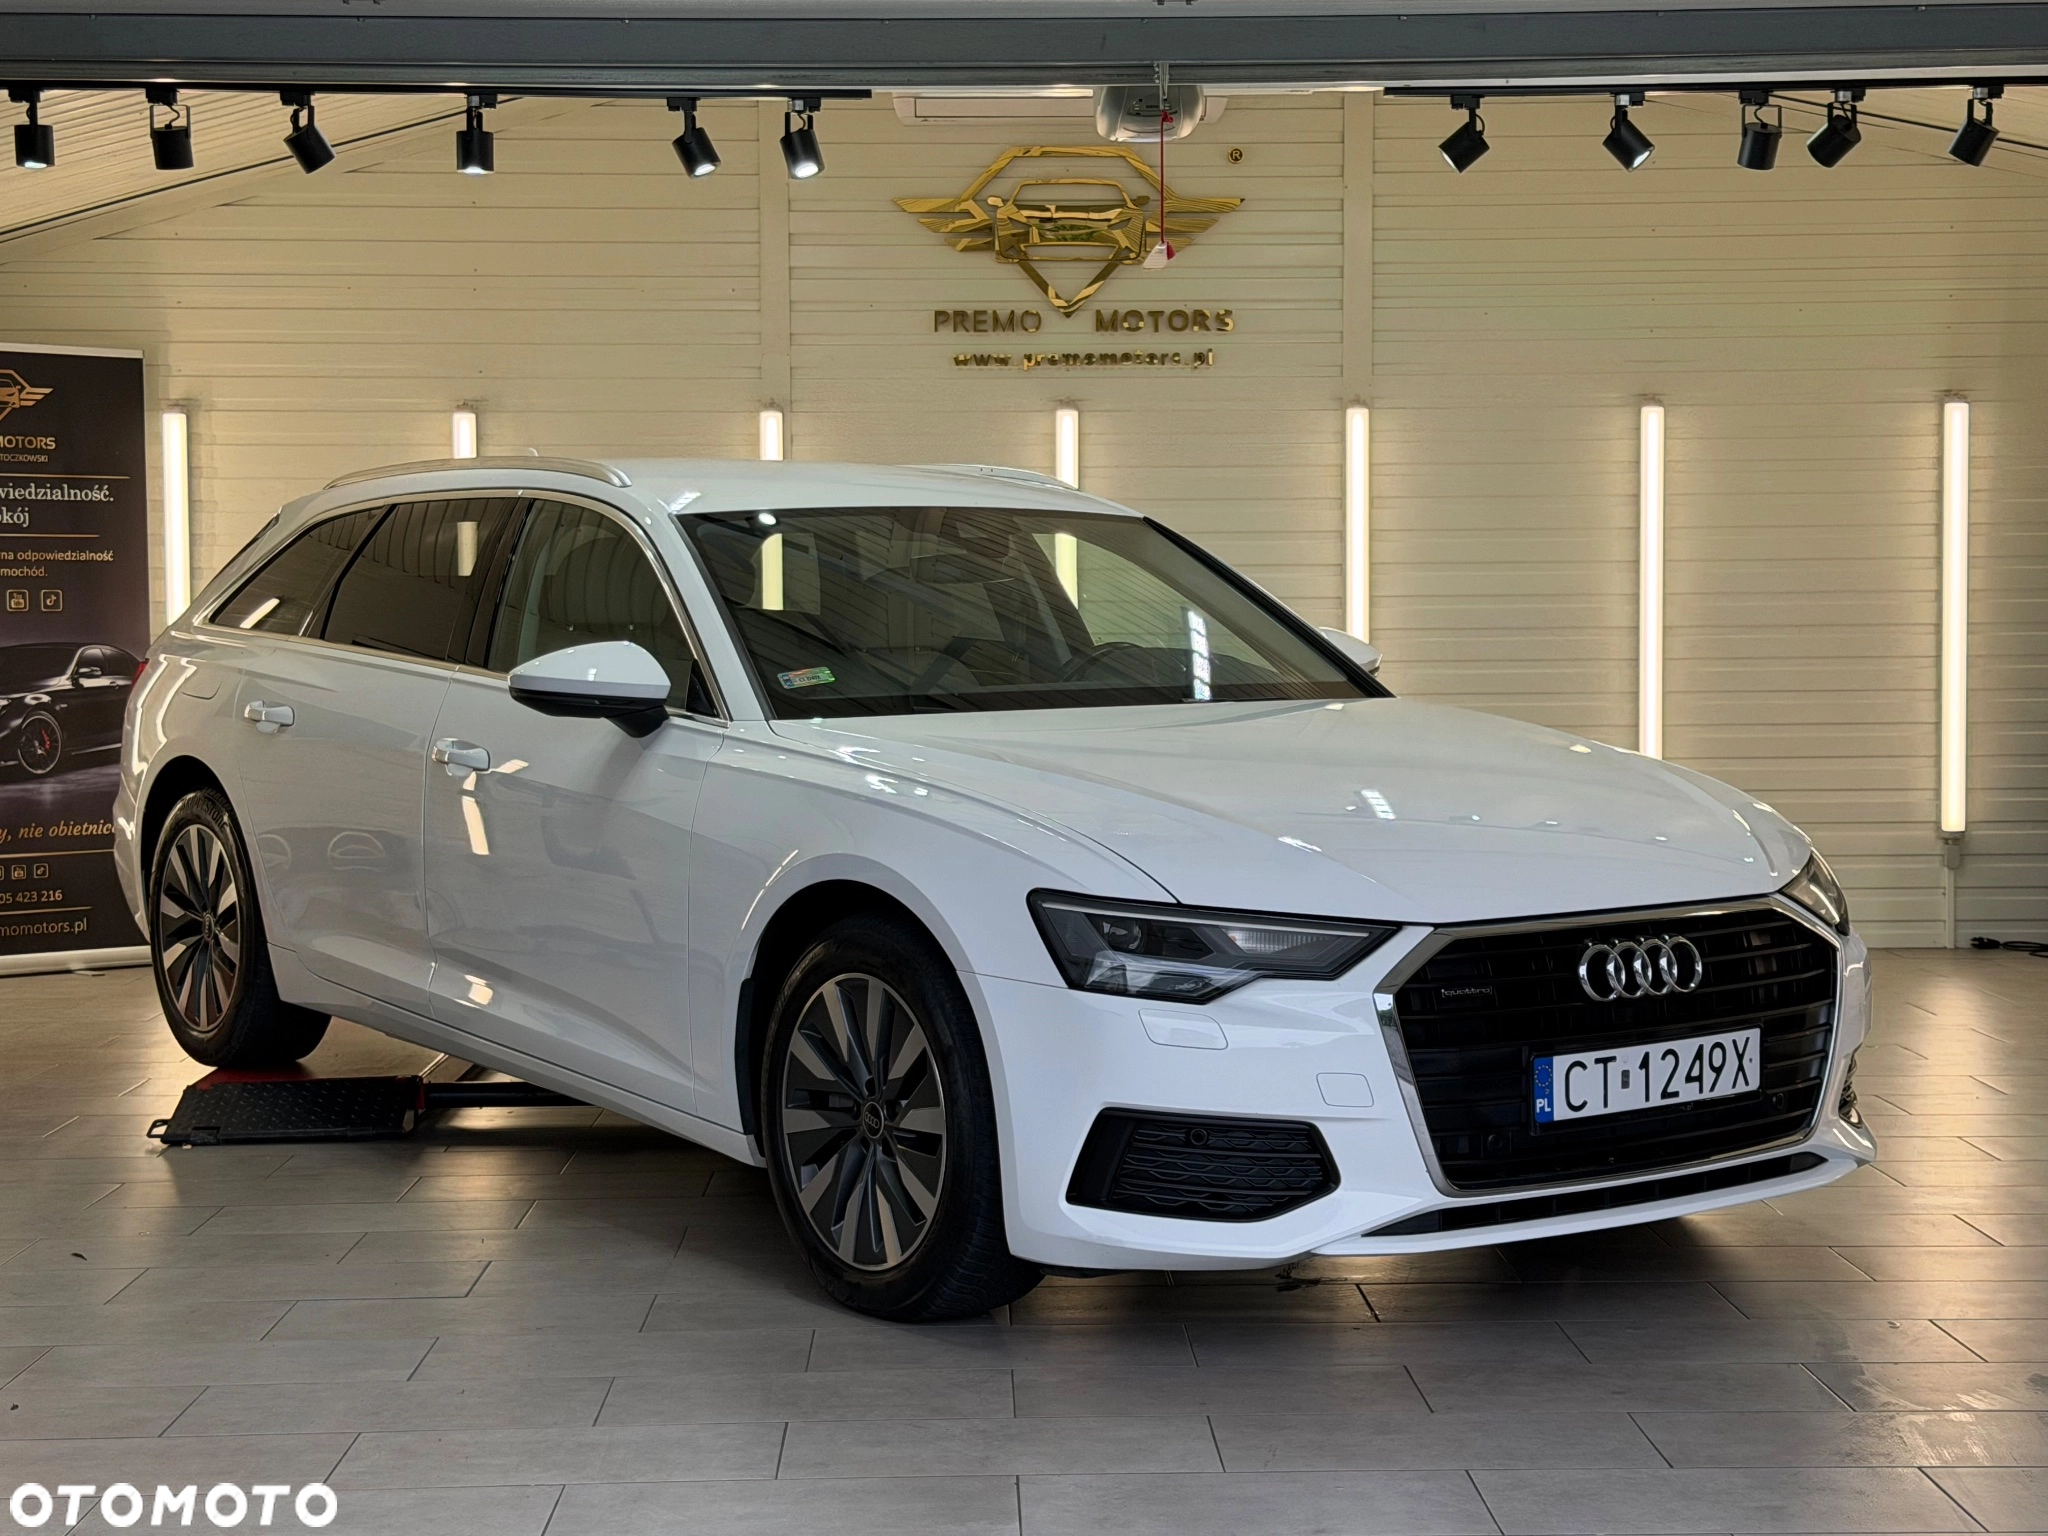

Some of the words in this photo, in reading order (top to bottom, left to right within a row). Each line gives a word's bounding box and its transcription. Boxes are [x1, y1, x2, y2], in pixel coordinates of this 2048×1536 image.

[934, 309, 1042, 333] PREMO
[1095, 308, 1236, 333] MOTORS
[953, 348, 1215, 371] www.premomotors.pl
[0, 435, 56, 450] OTORS
[0, 507, 30, 528] kój
[17, 549, 114, 563] odpowiedzialność
[18, 822, 44, 840] nie
[16, 890, 38, 903] 423
[41, 889, 63, 902] 216
[1564, 1055, 1618, 1113] CT
[1638, 1036, 1751, 1103] 1249X
[1536, 1098, 1552, 1114] PL
